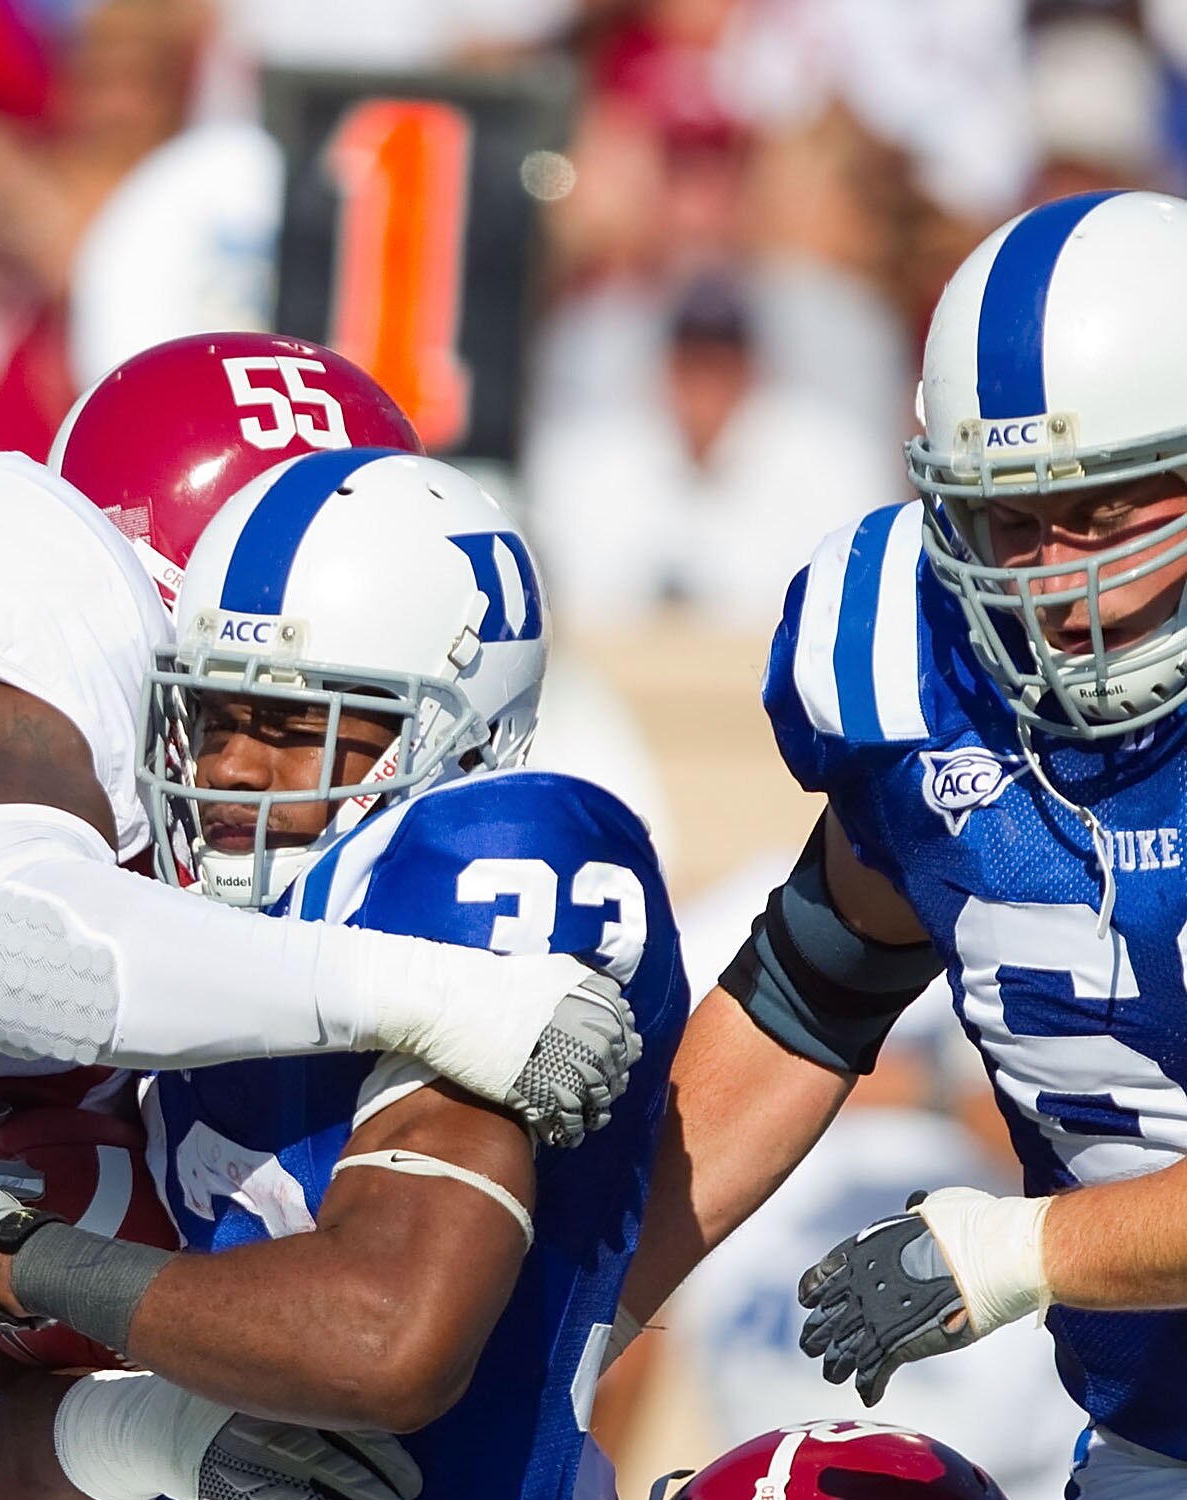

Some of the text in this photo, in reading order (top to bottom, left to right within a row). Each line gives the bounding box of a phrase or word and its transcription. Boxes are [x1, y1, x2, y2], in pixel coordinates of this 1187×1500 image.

[327, 98, 473, 446] 1
[222, 356, 352, 450] 55
[987, 422, 1038, 447] ACC
[220, 620, 272, 643] ACC
[1079, 684, 1125, 699] Riddell
[939, 772, 991, 798] ACC
[215, 875, 252, 887] Riddel
[457, 858, 648, 986] 33
